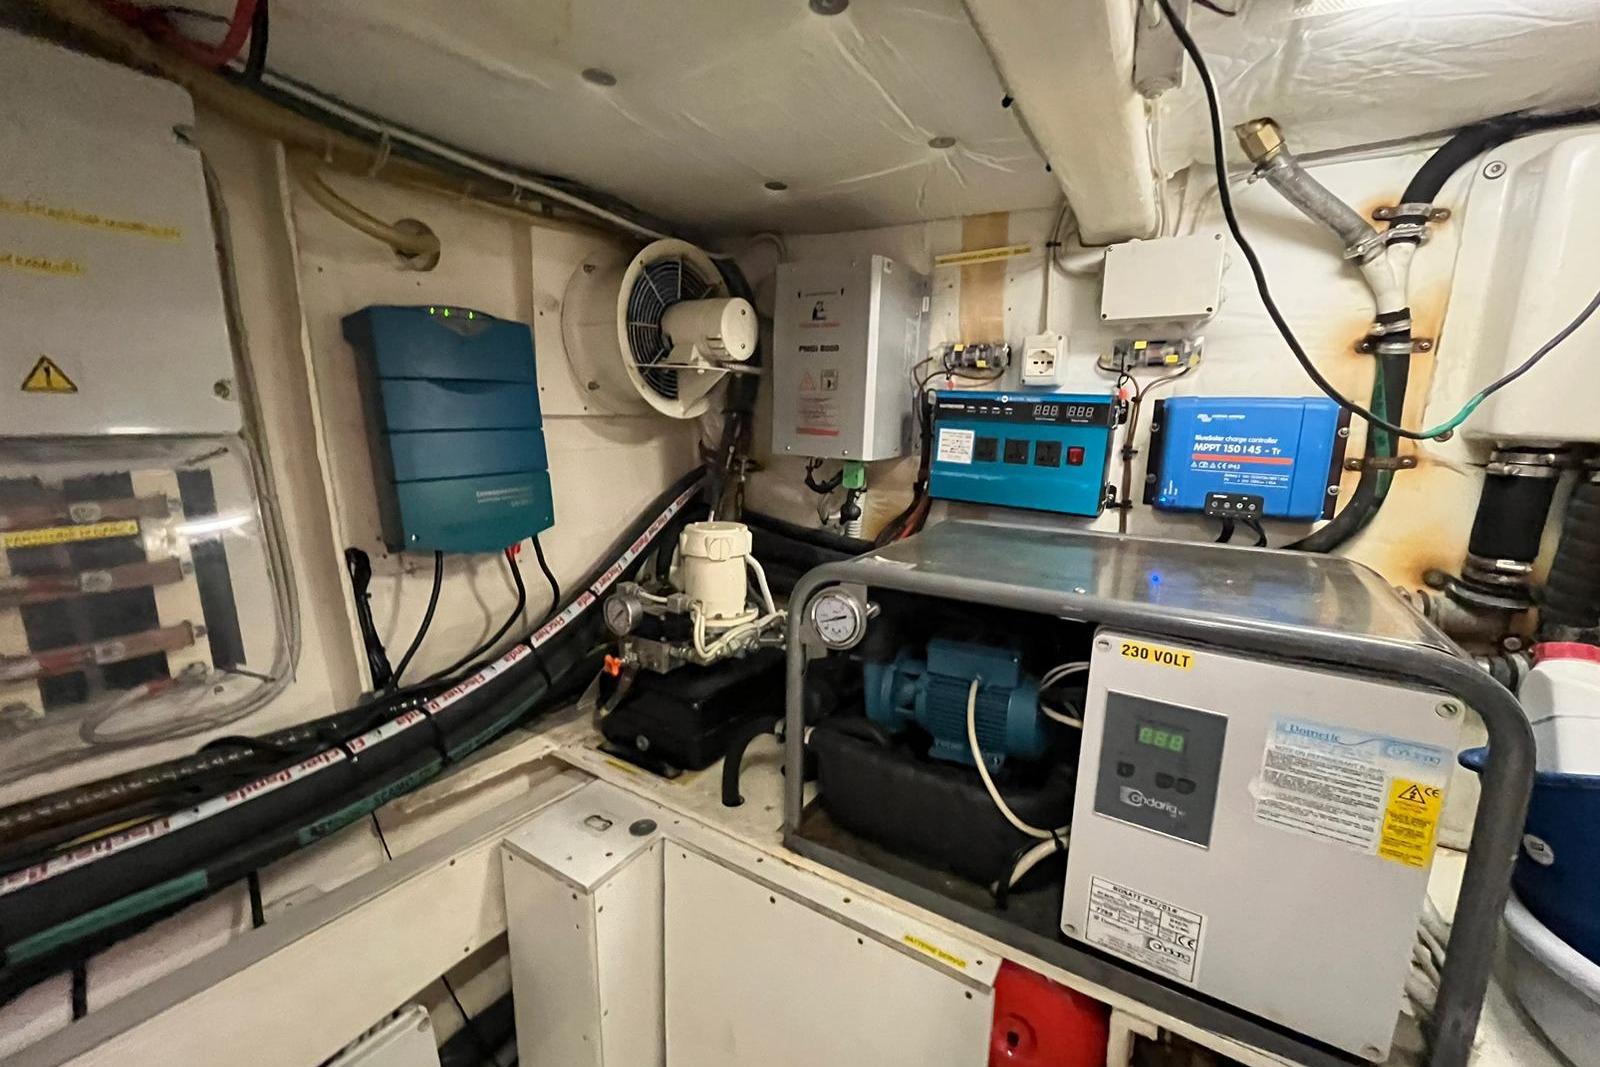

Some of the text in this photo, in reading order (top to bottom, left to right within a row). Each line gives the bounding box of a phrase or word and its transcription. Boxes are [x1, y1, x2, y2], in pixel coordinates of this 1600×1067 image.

[1193, 443, 1221, 452] MPPT
[1272, 447, 1282, 456] Tr
[1121, 643, 1191, 668] 230 VOLT
